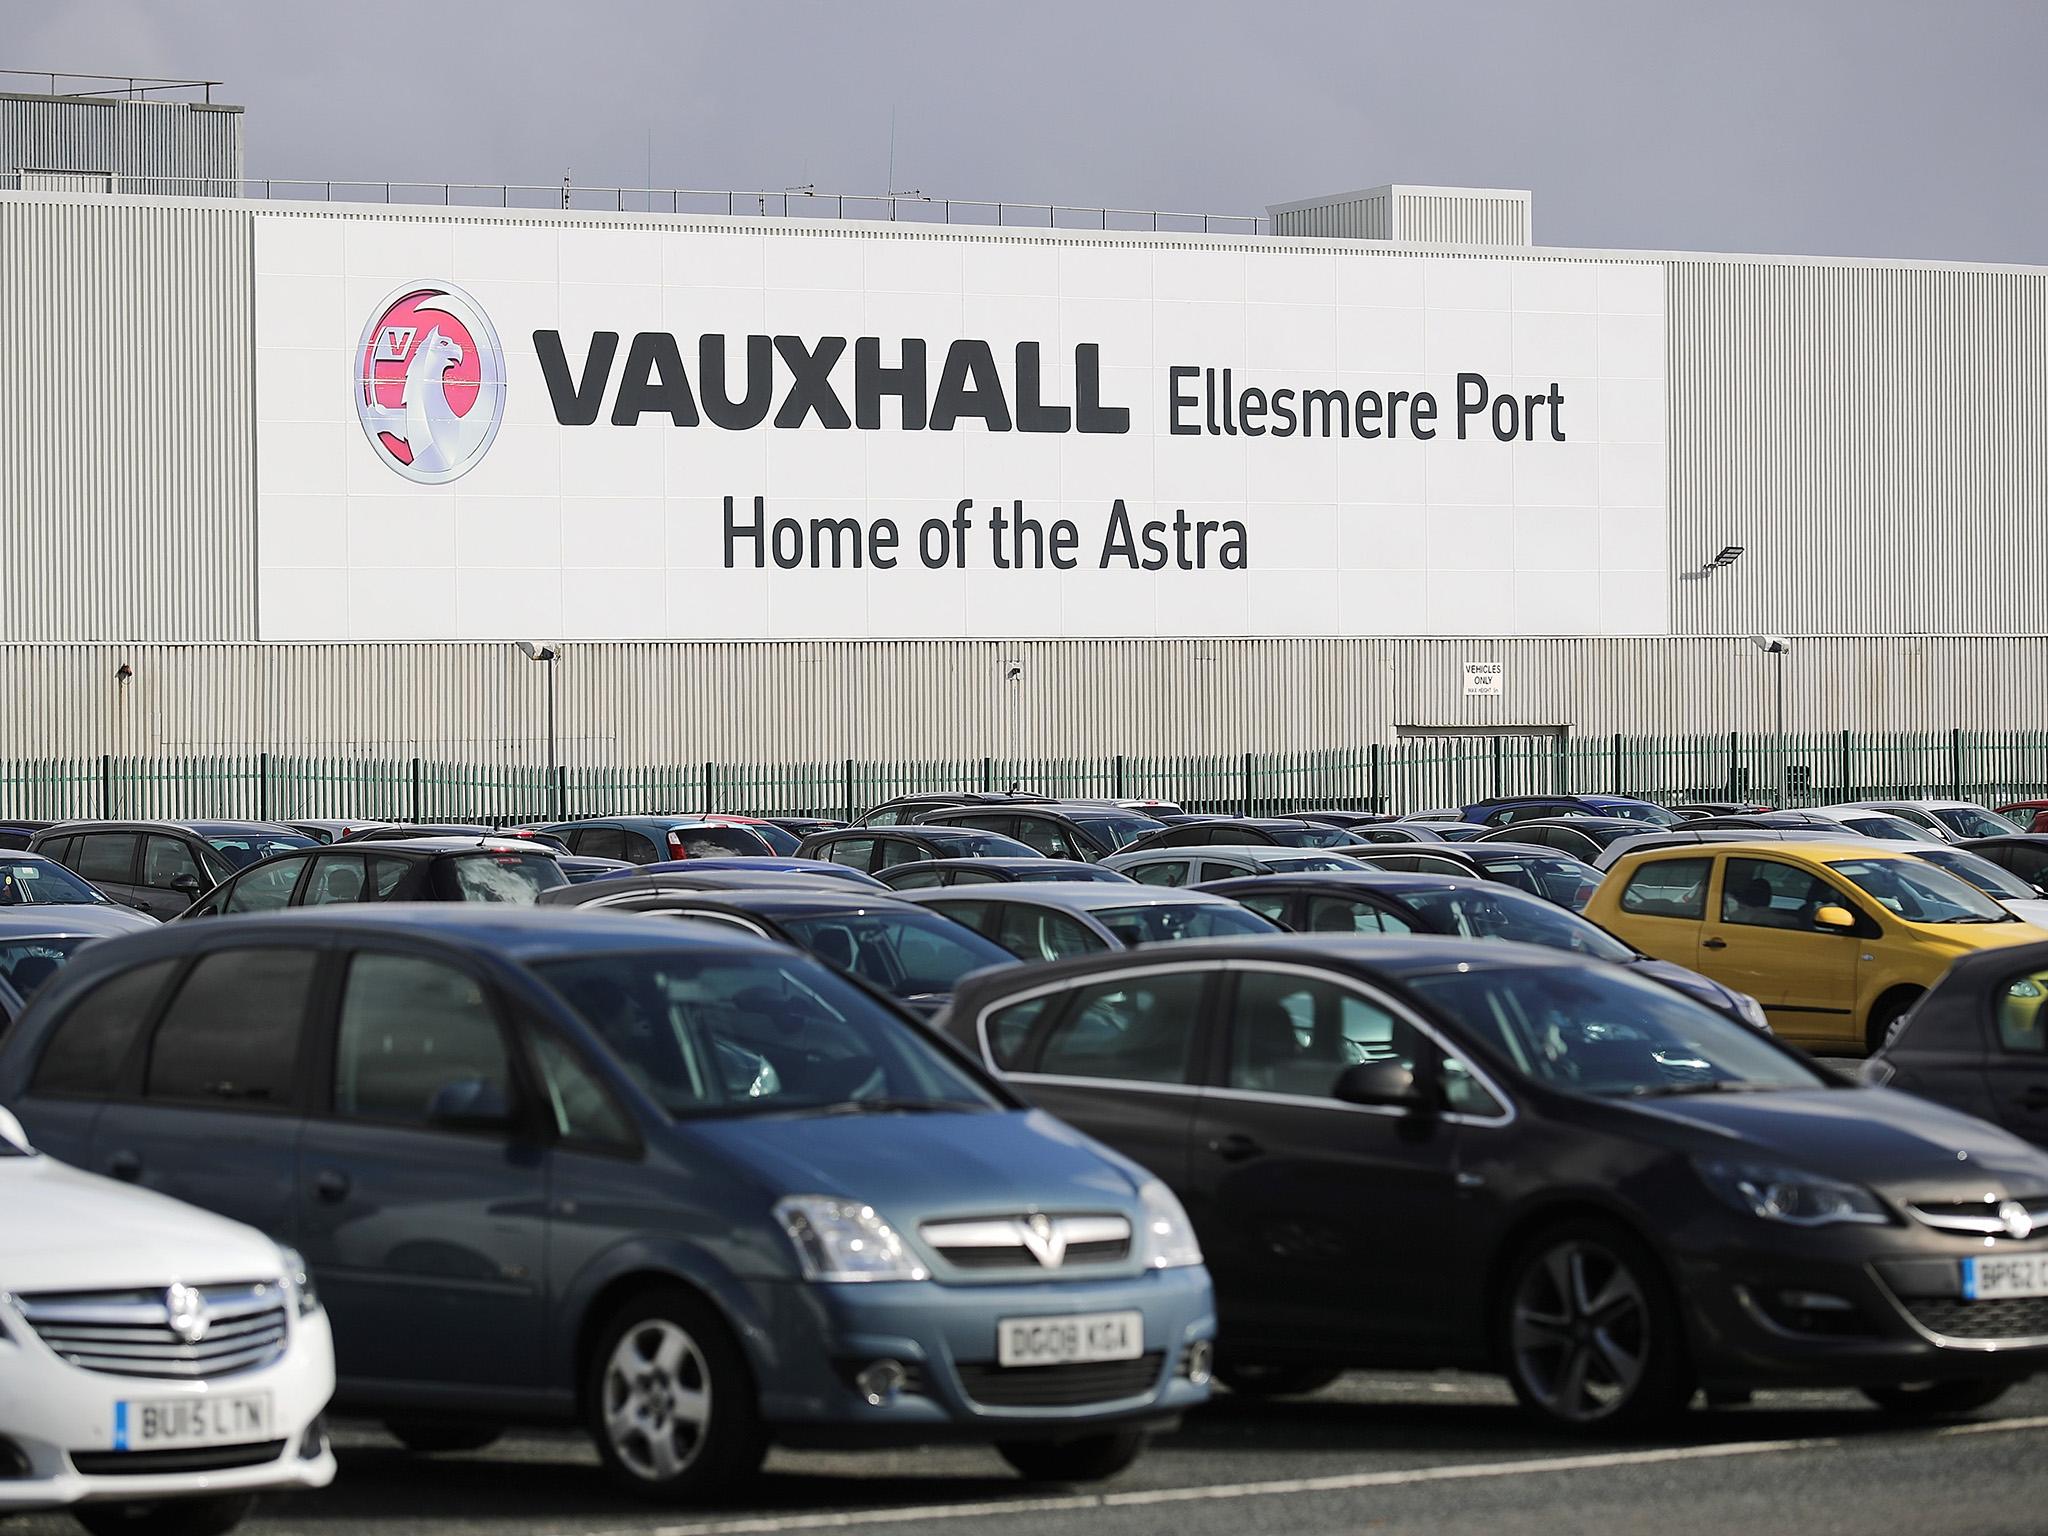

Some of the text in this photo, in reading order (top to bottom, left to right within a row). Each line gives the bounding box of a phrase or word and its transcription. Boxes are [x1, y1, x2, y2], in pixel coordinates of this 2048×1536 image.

[532, 329, 1567, 443] VAUXHALL Ellesmere Port
[723, 495, 1249, 571] Home of the Astra
[1465, 664, 1501, 674] VEHICLES
[1474, 675, 1493, 684] ONLY
[213, 1398, 262, 1435] LTN
